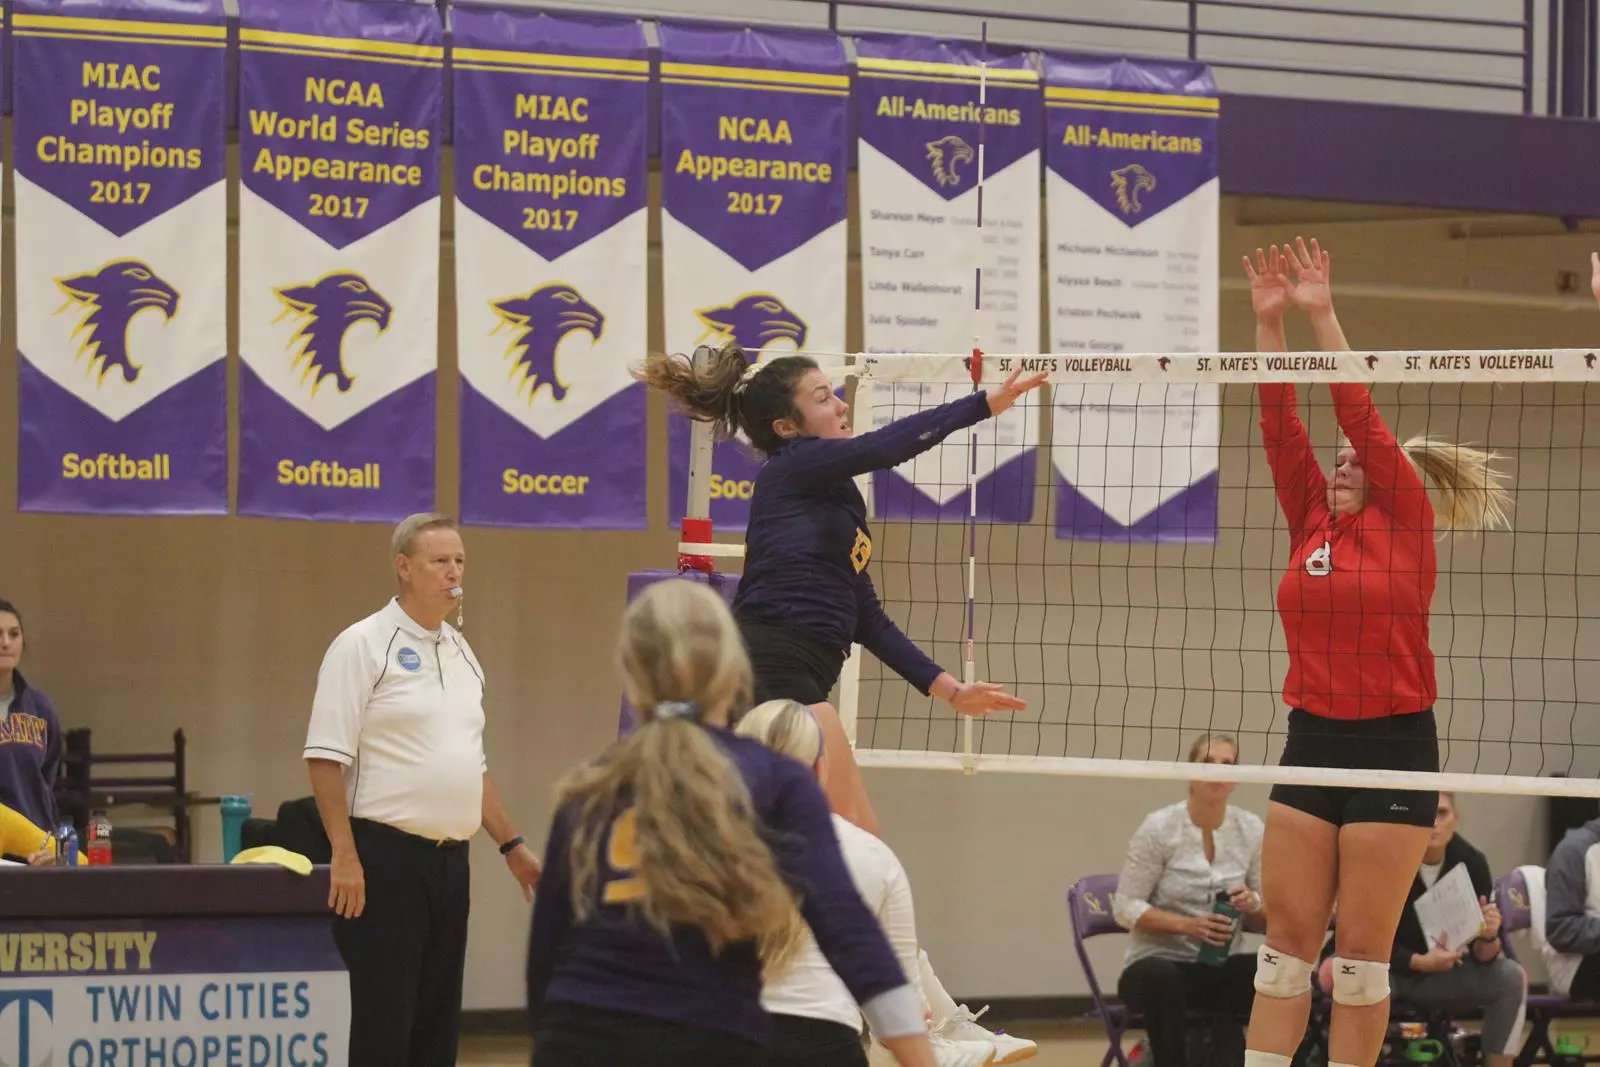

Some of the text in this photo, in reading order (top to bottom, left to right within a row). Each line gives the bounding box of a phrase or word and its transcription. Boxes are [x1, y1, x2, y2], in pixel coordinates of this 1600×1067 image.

[82, 62, 161, 91] MIAC
[305, 77, 384, 108] NCAA
[70, 99, 174, 133] Playoff
[515, 94, 588, 122] MIAC
[249, 110, 430, 149] World Series
[719, 116, 792, 144] NCAA
[1063, 124, 1203, 154] All-Americans
[36, 136, 202, 171] Champions
[504, 129, 599, 163] Playoff
[253, 147, 422, 187] Appearance
[676, 150, 832, 184] Appearance
[90, 180, 152, 205] 2017
[473, 164, 626, 200] Champions
[309, 193, 369, 219] 2017
[728, 191, 783, 216] 2017
[522, 207, 579, 232] 2017
[999, 358, 1132, 372] ST. KATE'S VOLLEYBALL
[1196, 356, 1338, 372] ST. KATE'S VOLLEYBALL
[1404, 355, 1554, 370] ST. KATE'S VOLLEYBALL
[62, 452, 171, 480] Softball
[277, 459, 381, 489] Softball
[502, 468, 589, 496] Soccer
[711, 474, 755, 500] Soc
[86, 981, 310, 1023] TWIN CITIES
[68, 1032, 328, 1067] ORTHOPEDICS
